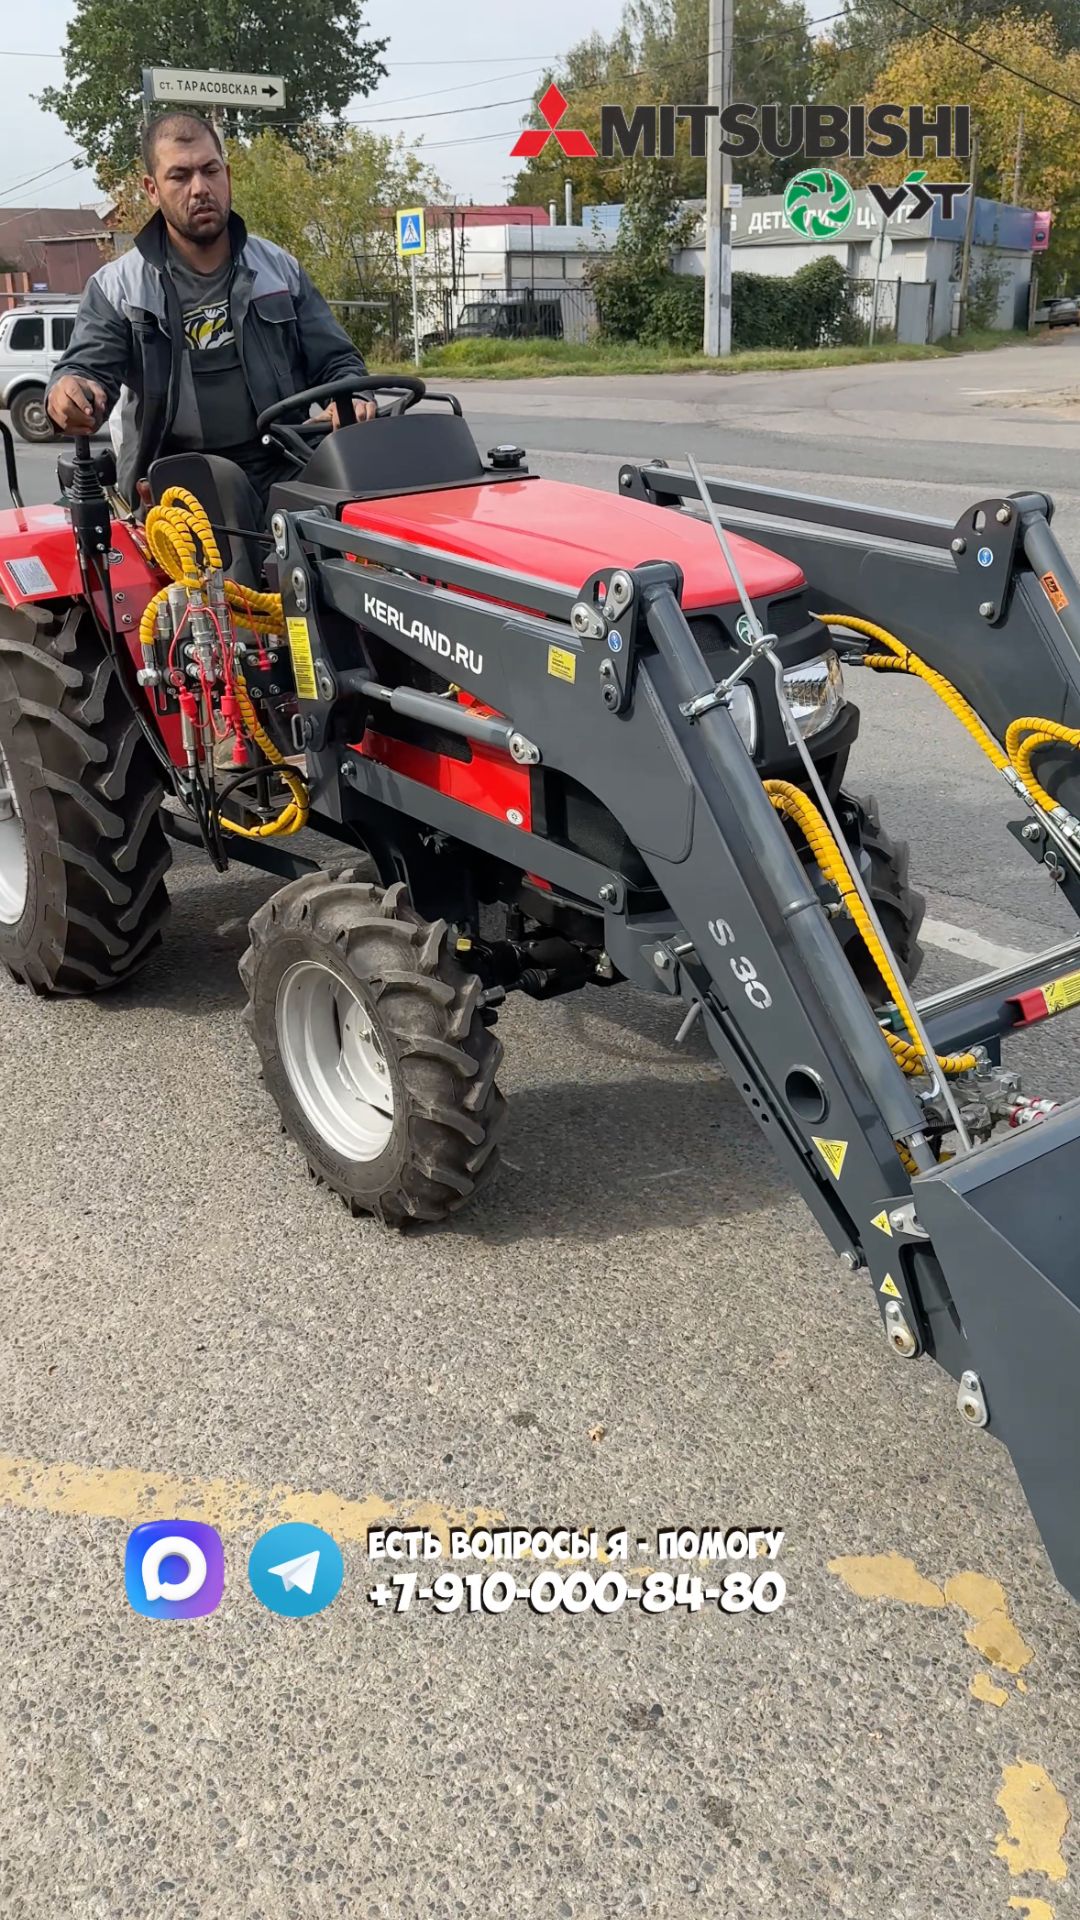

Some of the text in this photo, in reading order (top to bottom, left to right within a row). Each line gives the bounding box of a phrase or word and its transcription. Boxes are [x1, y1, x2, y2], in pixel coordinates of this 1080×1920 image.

[177, 80, 258, 96] ТАРАСОВСКАЯ
[364, 592, 483, 675] KERLAND.RU
[708, 918, 773, 1009] S 30
